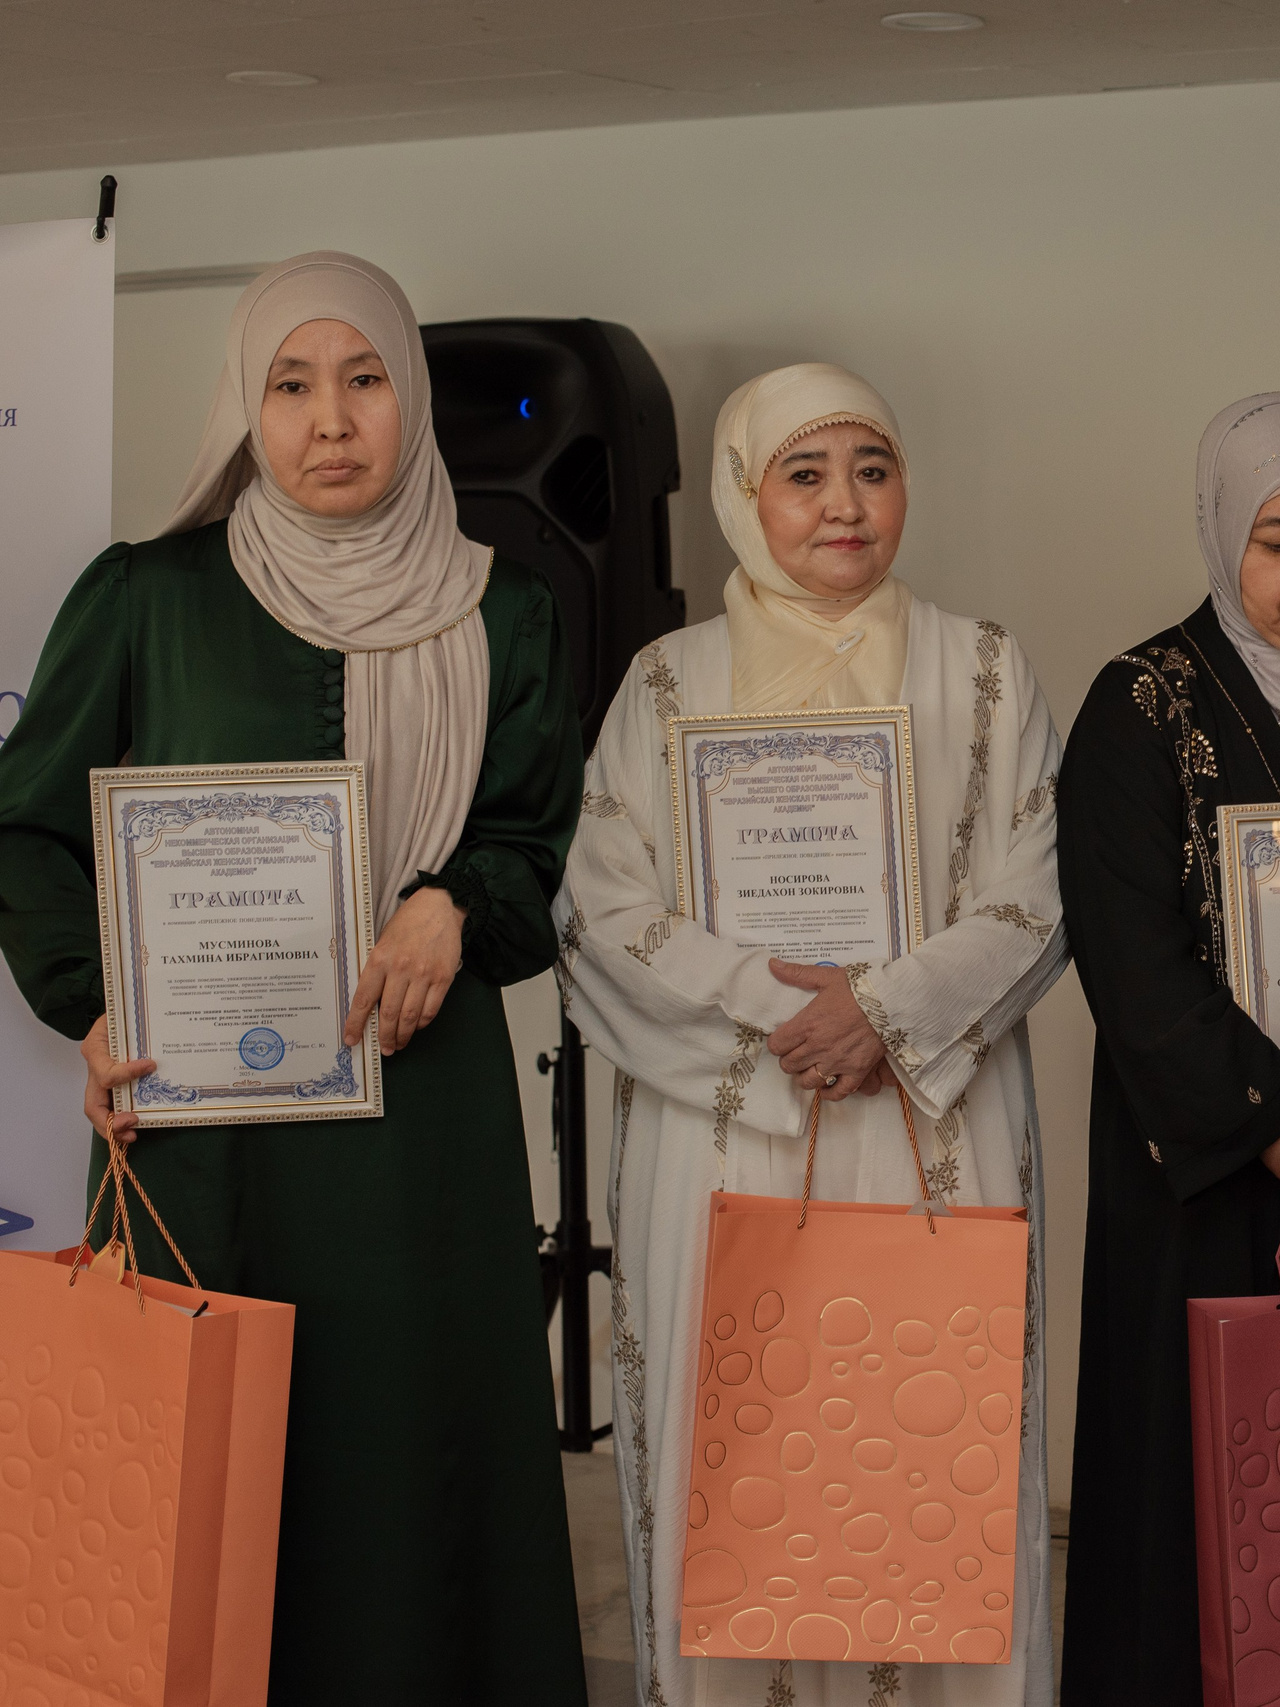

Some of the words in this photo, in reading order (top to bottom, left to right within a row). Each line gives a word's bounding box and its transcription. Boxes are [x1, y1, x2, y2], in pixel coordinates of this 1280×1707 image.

[736, 824, 858, 844] ГРАМОТА
[769, 874, 830, 884] НОСИРОВА
[737, 888, 795, 898] ЗИЕДАХОН
[798, 885, 864, 895] ЗОКИРОВНА
[168, 888, 304, 909] ГРАМОТА
[199, 938, 279, 950] МУСМИНОВА
[161, 954, 222, 964] ТАХМИНА
[226, 950, 318, 962] ИБРАГИМОВНА
